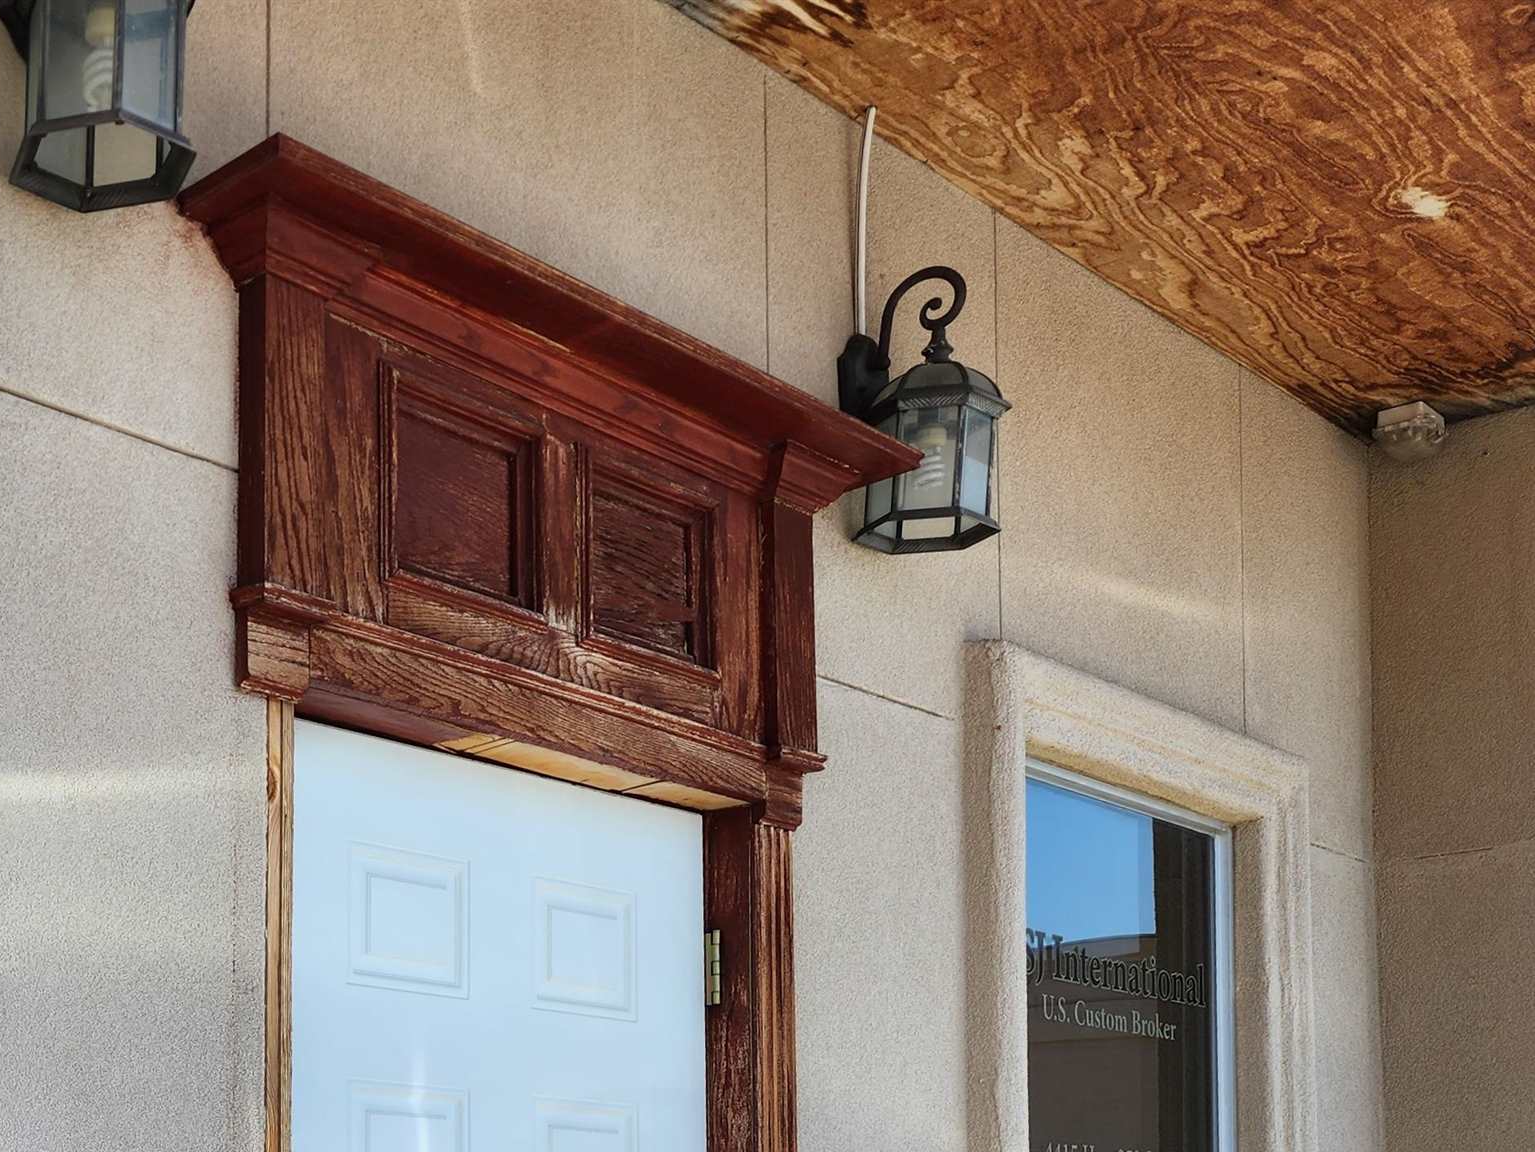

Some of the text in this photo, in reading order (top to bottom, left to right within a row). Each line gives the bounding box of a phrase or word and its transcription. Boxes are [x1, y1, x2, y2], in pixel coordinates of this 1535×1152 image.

[1052, 934, 1207, 1009] International
[1041, 993, 1177, 1041] U.S. Custom Broker
